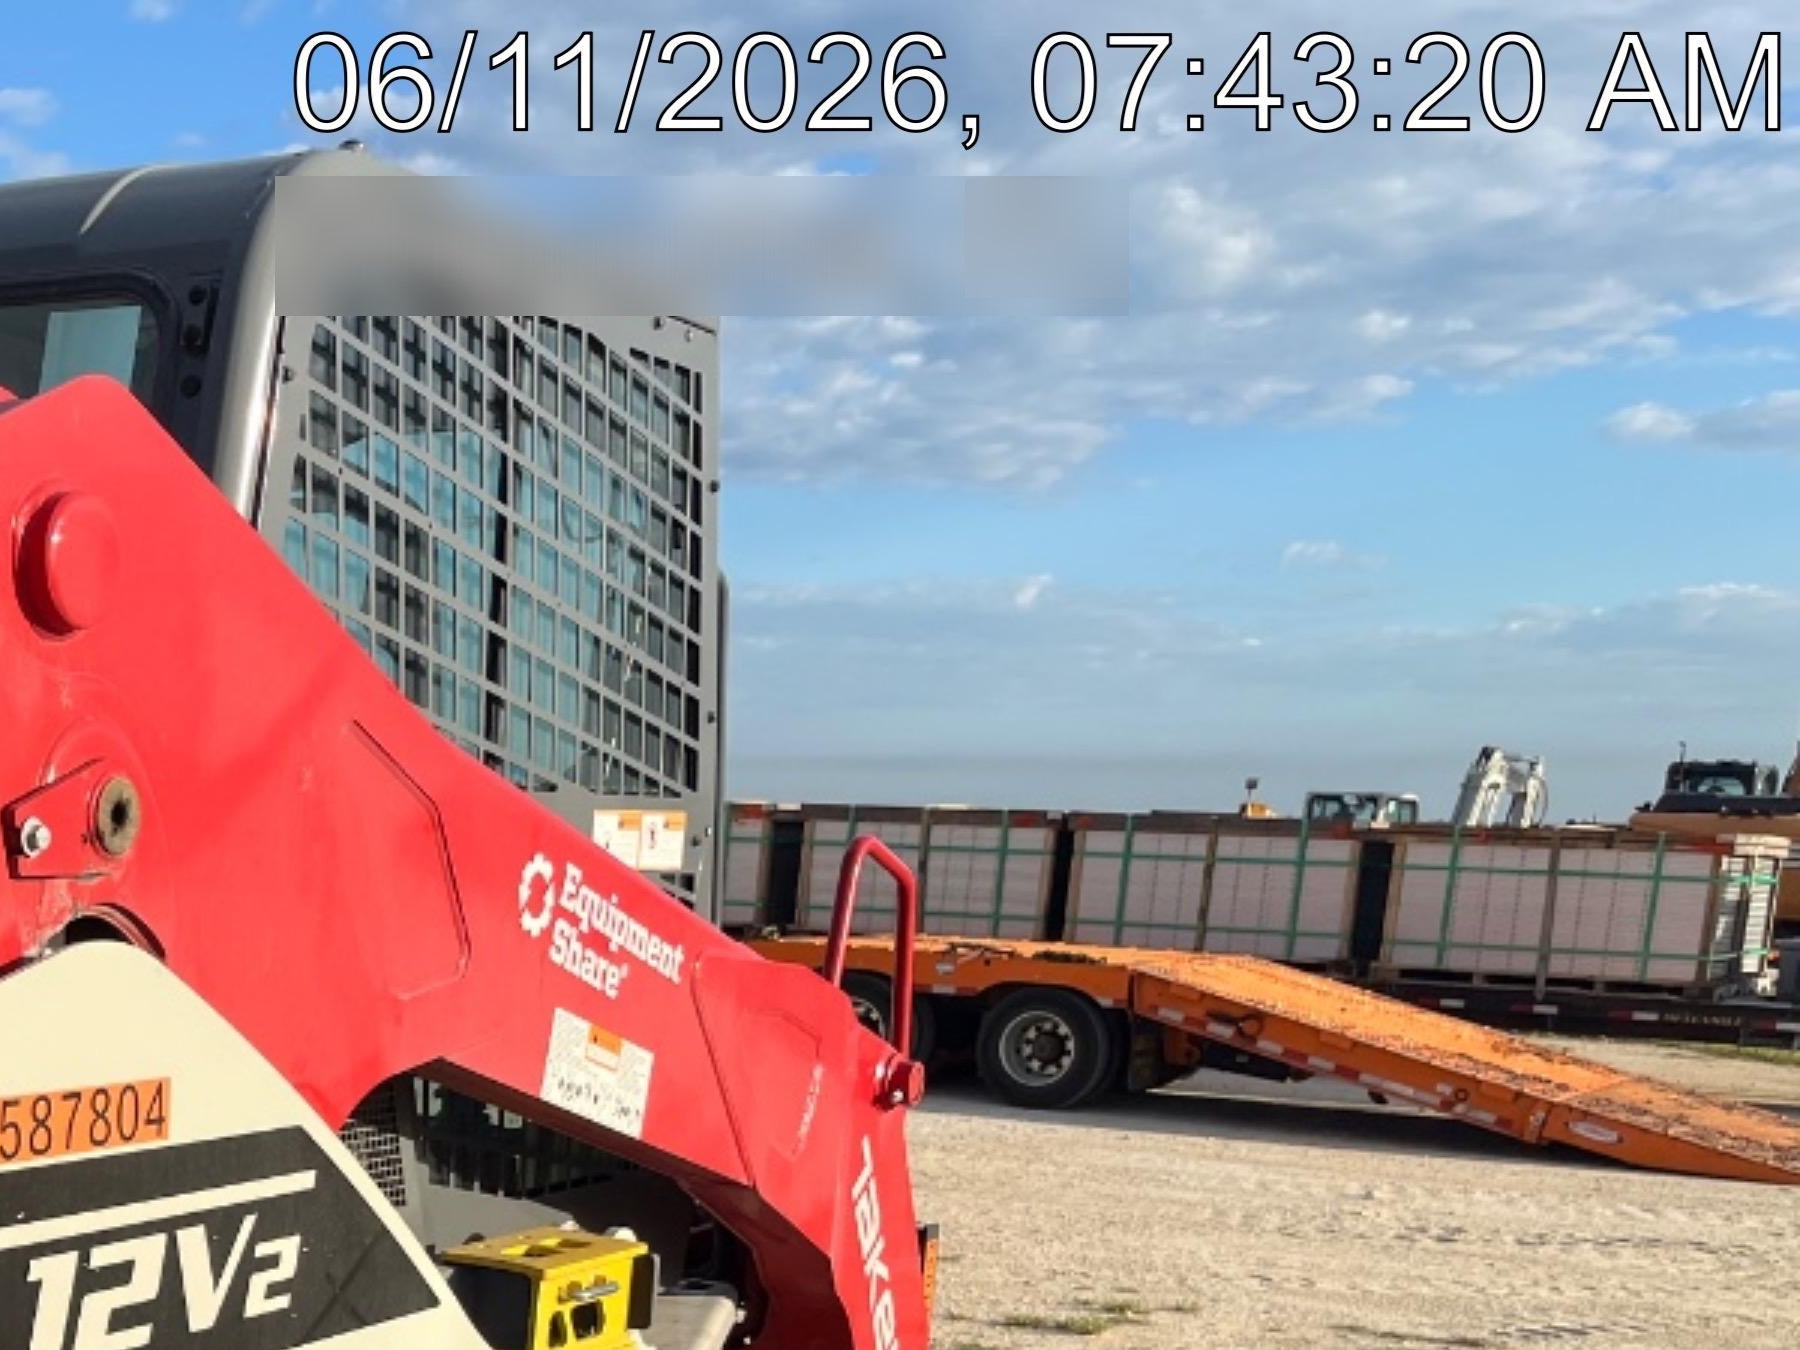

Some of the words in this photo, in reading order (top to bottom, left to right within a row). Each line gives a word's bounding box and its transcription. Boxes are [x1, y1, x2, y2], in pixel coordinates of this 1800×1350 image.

[550, 918, 622, 1000] Share
[559, 861, 686, 985] Equipment
[0, 1080, 166, 1161] 587804
